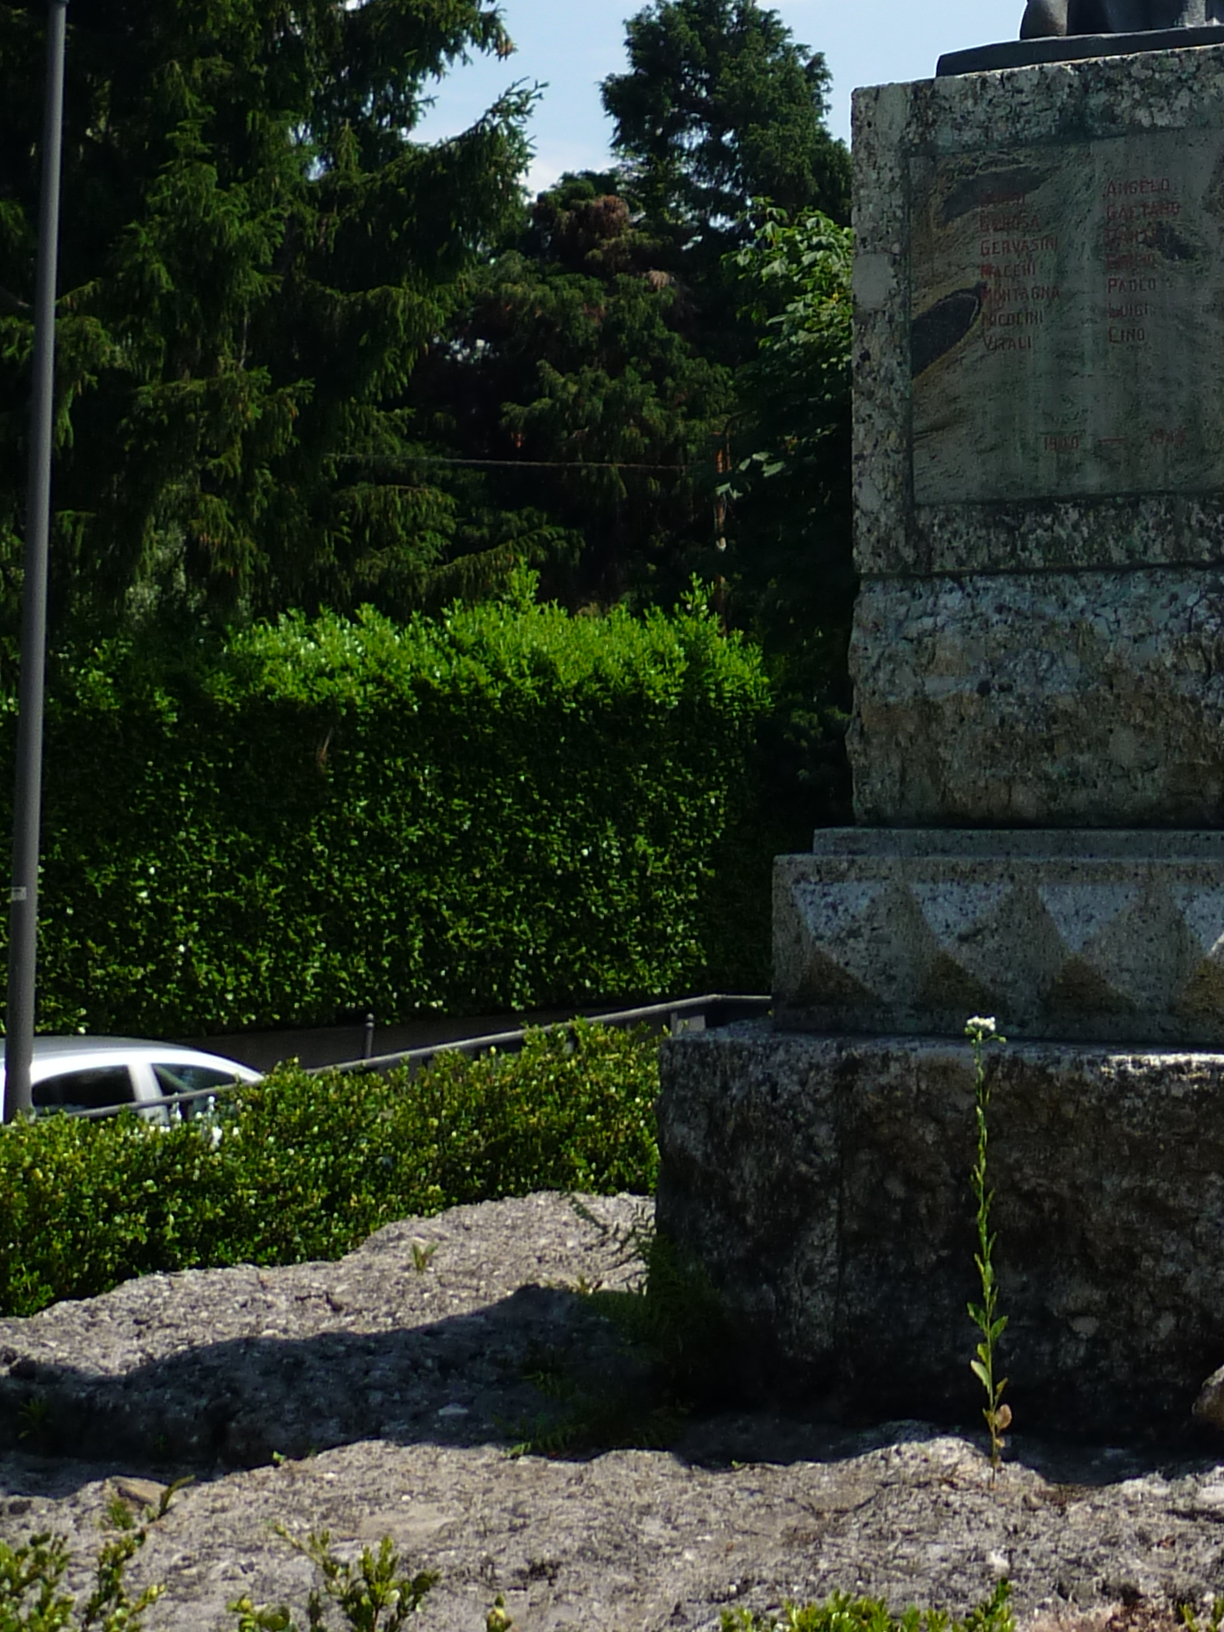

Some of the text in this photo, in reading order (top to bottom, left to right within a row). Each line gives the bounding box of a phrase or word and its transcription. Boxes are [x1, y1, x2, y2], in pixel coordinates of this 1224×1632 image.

[1106, 178, 1170, 197] ANGELO
[980, 236, 1059, 256] GERVASINI
[980, 277, 1157, 303] MONTAGNA PAOLO
[1108, 302, 1149, 320] LUIGI
[981, 332, 1032, 351] VITALI
